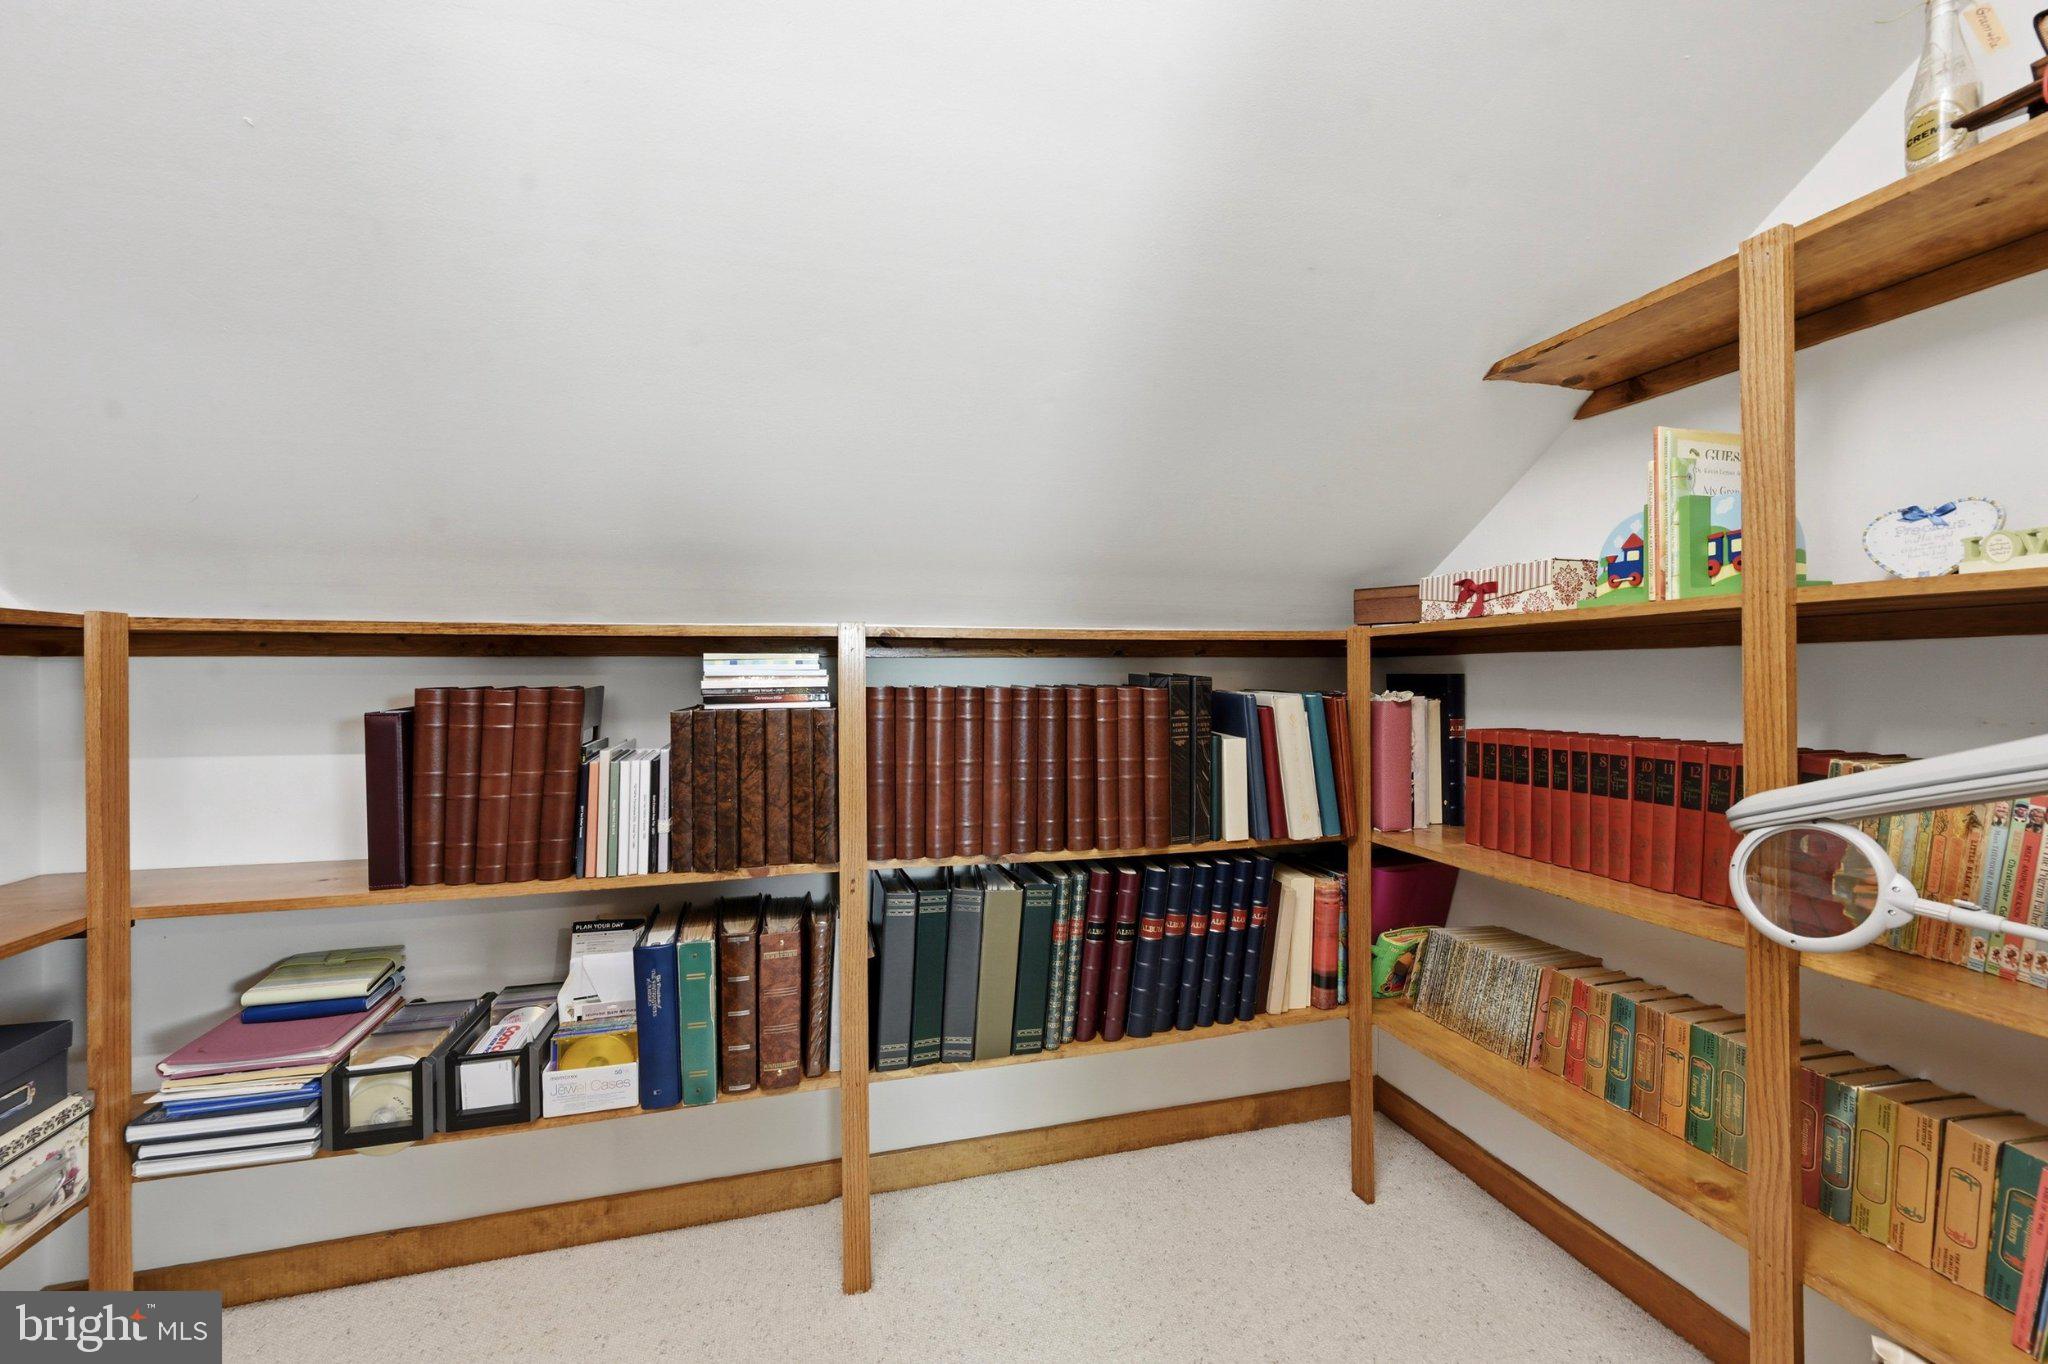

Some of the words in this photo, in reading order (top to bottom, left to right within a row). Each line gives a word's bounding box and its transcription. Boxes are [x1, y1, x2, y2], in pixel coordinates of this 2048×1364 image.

[1489, 745, 1496, 756] 2
[1521, 749, 1528, 759] 4
[1541, 750, 1547, 760] 5
[1560, 752, 1567, 763] 6
[1600, 756, 1607, 767] 8
[1620, 759, 1627, 770] 9
[1641, 760, 1653, 773] 10
[1664, 763, 1673, 775] 11
[1690, 766, 1701, 778] 12
[1718, 768, 1729, 781] 13
[2001, 858, 2016, 902] Christopher
[591, 1079, 631, 1091] Cases
[2006, 1213, 2023, 1245] Library
